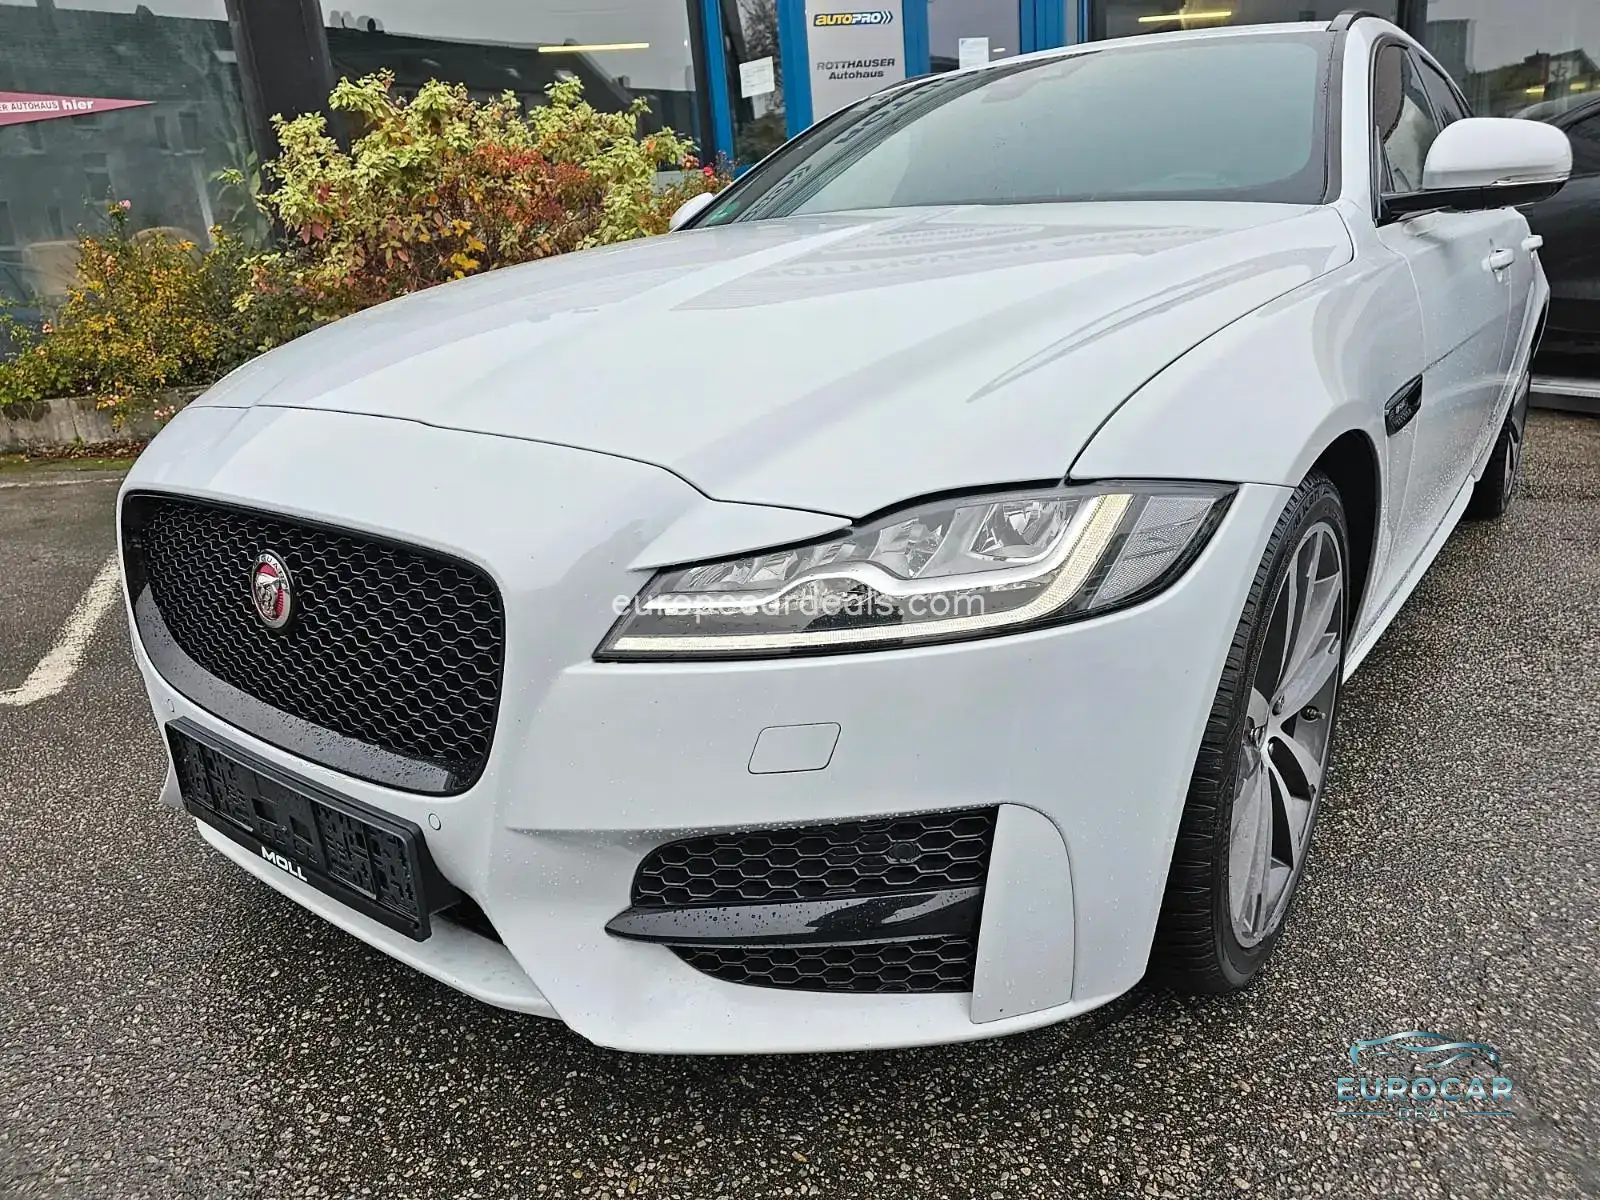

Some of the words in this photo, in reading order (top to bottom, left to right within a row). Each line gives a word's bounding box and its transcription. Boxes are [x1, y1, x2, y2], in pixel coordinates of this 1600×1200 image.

[817, 58, 896, 71] ROTTHAUSER
[829, 70, 884, 80] Autohaus
[11, 101, 58, 110] AUTOHAUS
[62, 99, 94, 110] hier
[261, 846, 308, 882] MOLL
